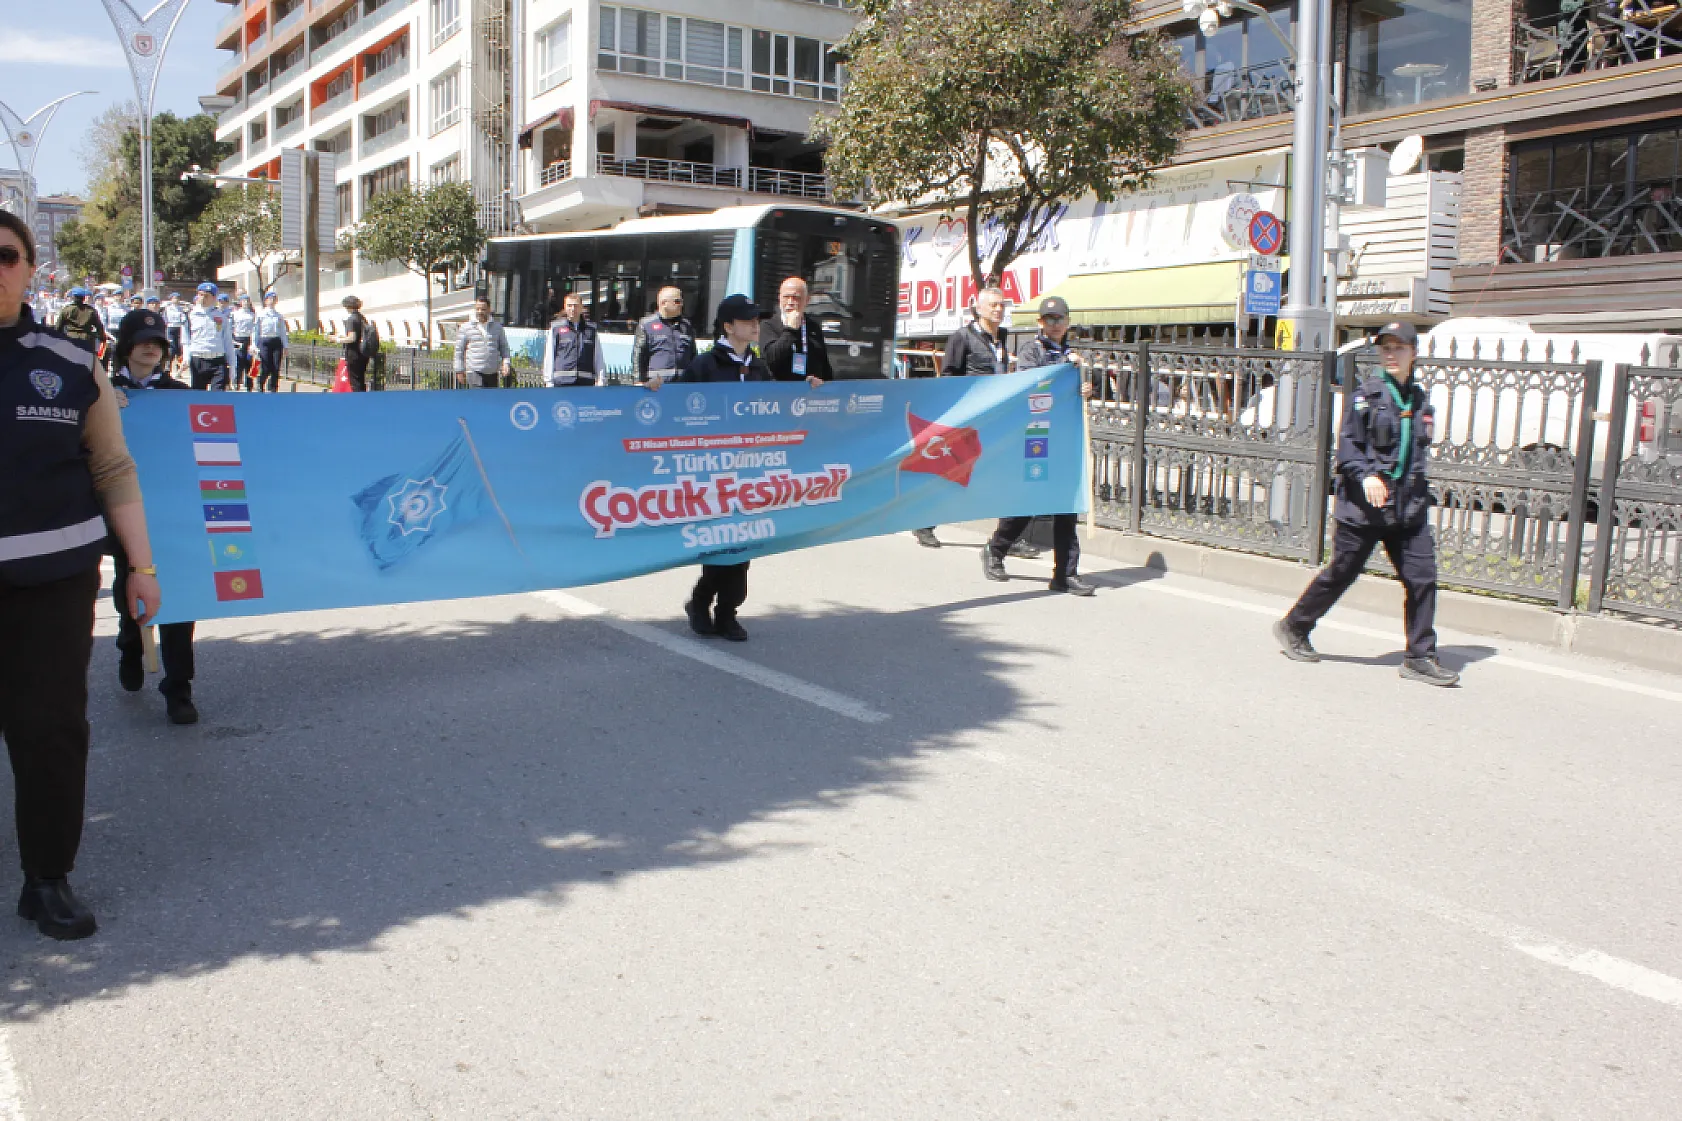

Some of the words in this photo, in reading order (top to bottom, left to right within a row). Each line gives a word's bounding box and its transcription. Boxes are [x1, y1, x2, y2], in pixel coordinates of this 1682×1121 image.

[15, 405, 79, 420] SAMSUN
[749, 398, 780, 416] TİKA
[629, 440, 642, 450] 23
[643, 439, 668, 449] Nisan
[669, 438, 697, 447] Ulusal
[652, 455, 671, 475] 2.
[672, 452, 720, 473] Türk
[720, 450, 787, 470] Dünyası
[582, 478, 714, 535] Çocuk
[714, 467, 849, 515] Festivali
[680, 517, 777, 548] Samsun
